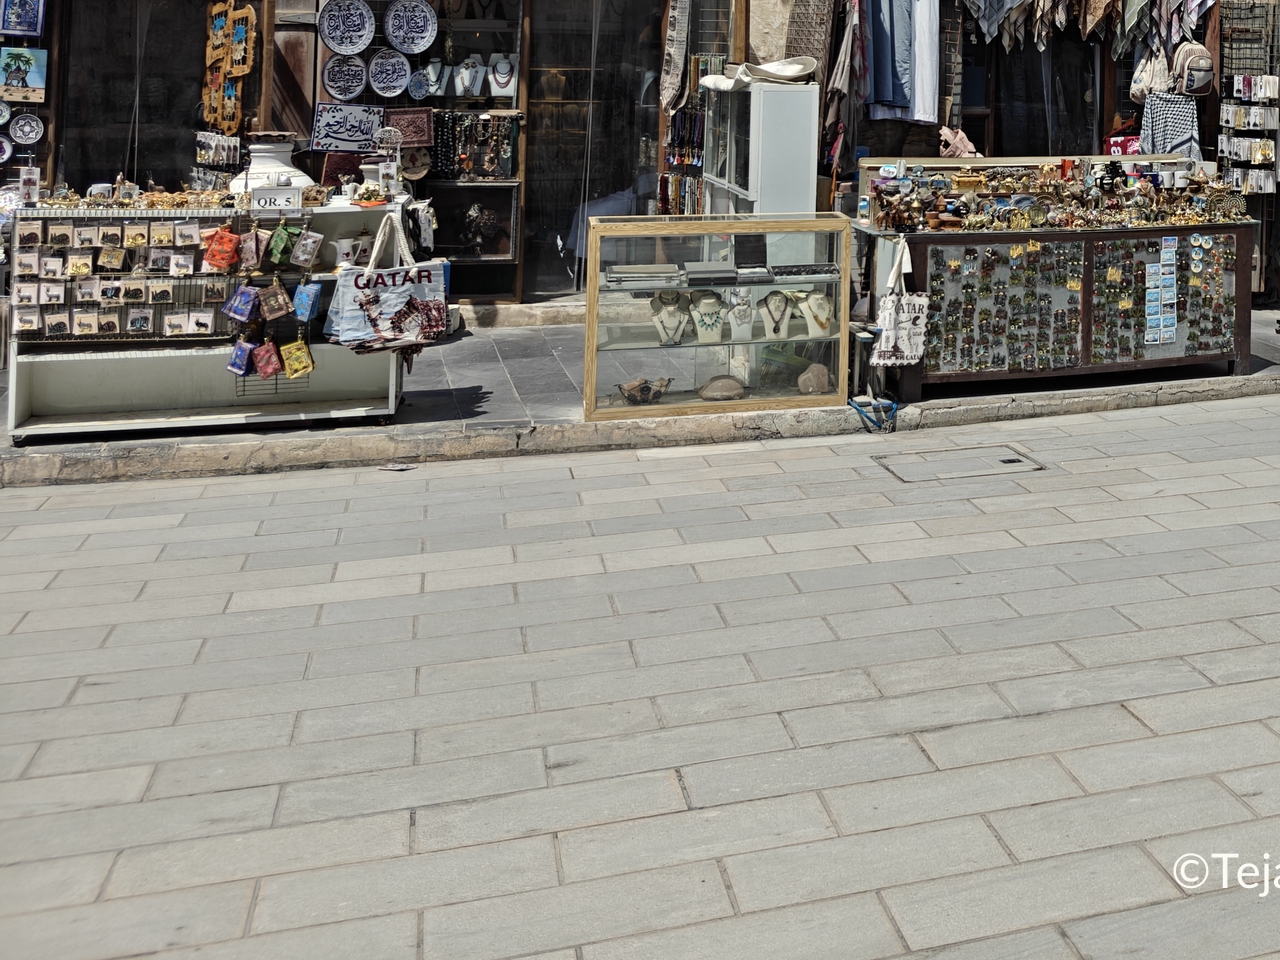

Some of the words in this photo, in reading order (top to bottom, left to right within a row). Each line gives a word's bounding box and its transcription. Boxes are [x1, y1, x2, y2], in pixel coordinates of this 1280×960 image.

[257, 197, 281, 209] QR.
[285, 197, 292, 207] 5
[354, 269, 432, 290] QATAR
